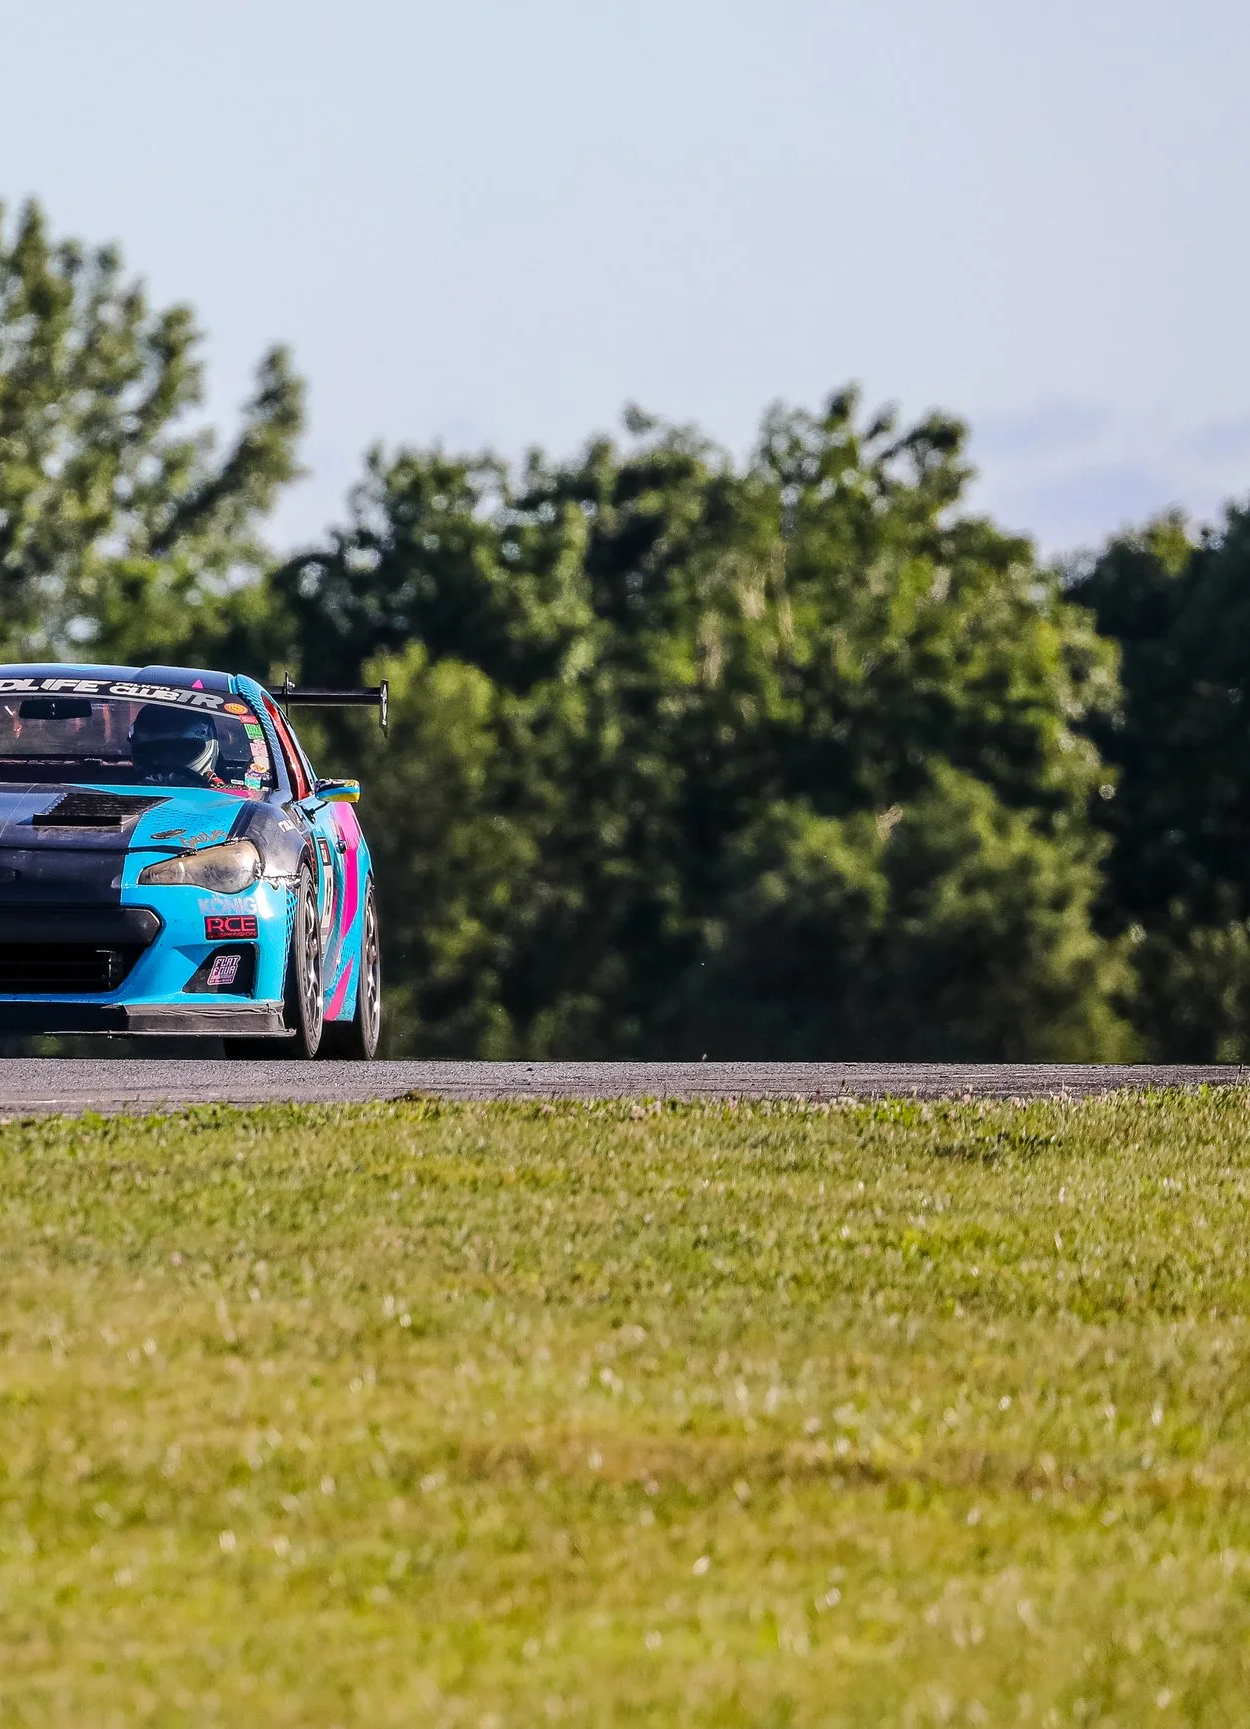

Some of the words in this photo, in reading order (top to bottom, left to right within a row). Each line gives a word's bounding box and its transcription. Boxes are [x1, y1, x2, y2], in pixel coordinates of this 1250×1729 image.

[206, 917, 256, 932] RCE
[215, 956, 240, 967] FLAT
[211, 965, 237, 976] FOUR
